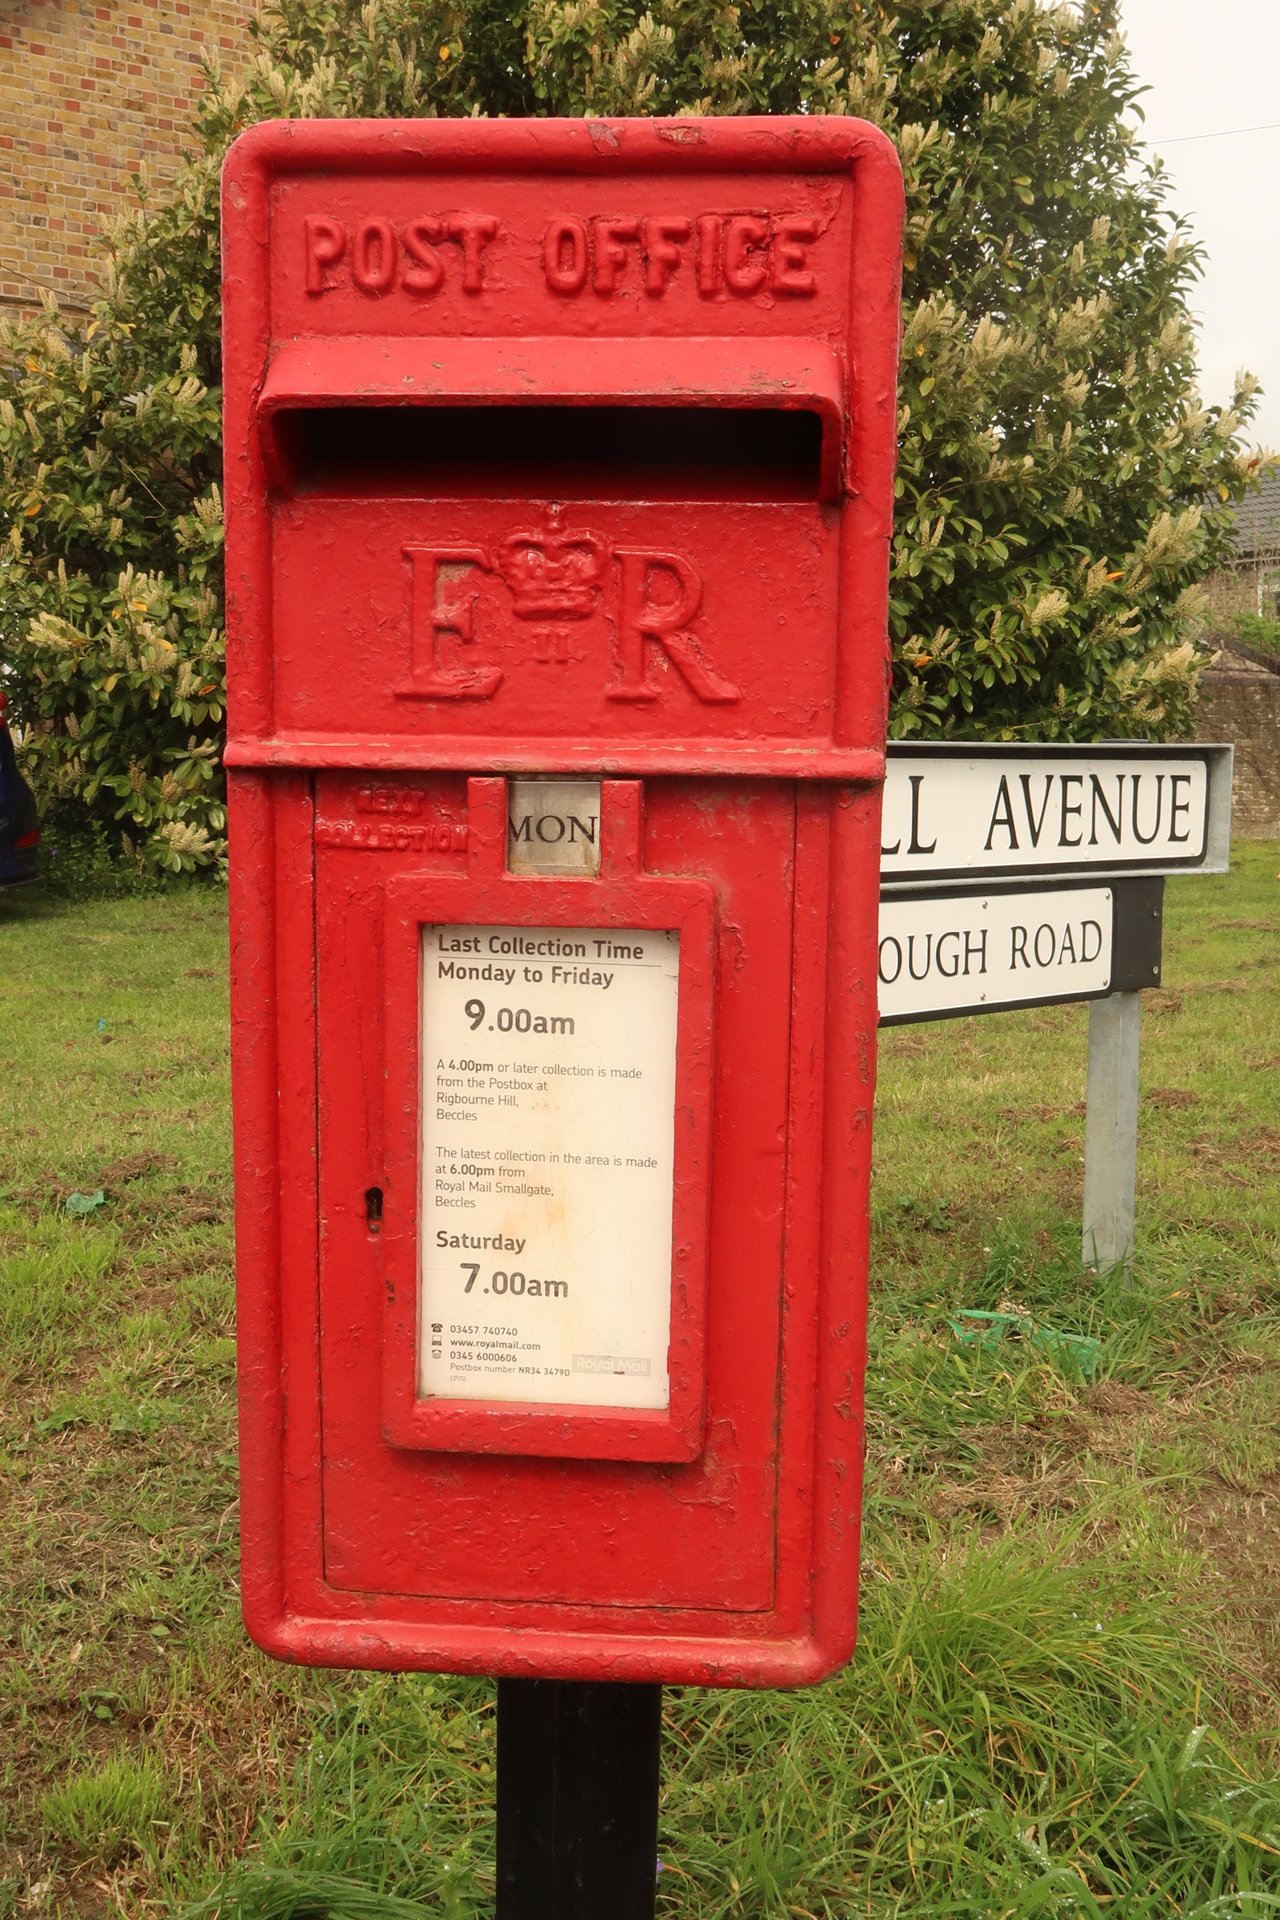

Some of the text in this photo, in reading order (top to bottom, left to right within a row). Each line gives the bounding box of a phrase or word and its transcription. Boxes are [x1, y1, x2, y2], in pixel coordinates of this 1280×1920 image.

[303, 211, 817, 299] POST OFFICE
[394, 540, 503, 701] E
[604, 544, 744, 704] R
[984, 774, 1191, 850] AVENUE
[508, 815, 598, 844] MON
[438, 934, 644, 959] Last Collection Time
[878, 920, 1102, 984] OUGH ROAD
[438, 961, 614, 989] Monday to Friday
[465, 999, 575, 1035] 9.00am
[437, 1059, 642, 1079] A 4.00pm or later collection is made
[436, 1076, 548, 1091] from the Postbox at
[437, 1092, 519, 1107] Rigbourne Hill,
[437, 1109, 477, 1121] Beccles
[436, 1147, 658, 1168] The latest collection in the area is made
[435, 1164, 525, 1177] at 6.00pm from
[436, 1180, 554, 1197] Royal Mail Smallgate,
[435, 1196, 475, 1208] Beccles
[436, 1231, 526, 1254] Saturday
[460, 1263, 568, 1298] 7.00am
[450, 1325, 518, 1336] 03457 740740
[450, 1340, 541, 1351] www.royalmail.com
[450, 1351, 517, 1362] 0345 6000606
[577, 1357, 647, 1373] Royal Mail
[450, 1363, 481, 1372] Postbox
[484, 1365, 516, 1374] number
[518, 1366, 541, 1375] NR34
